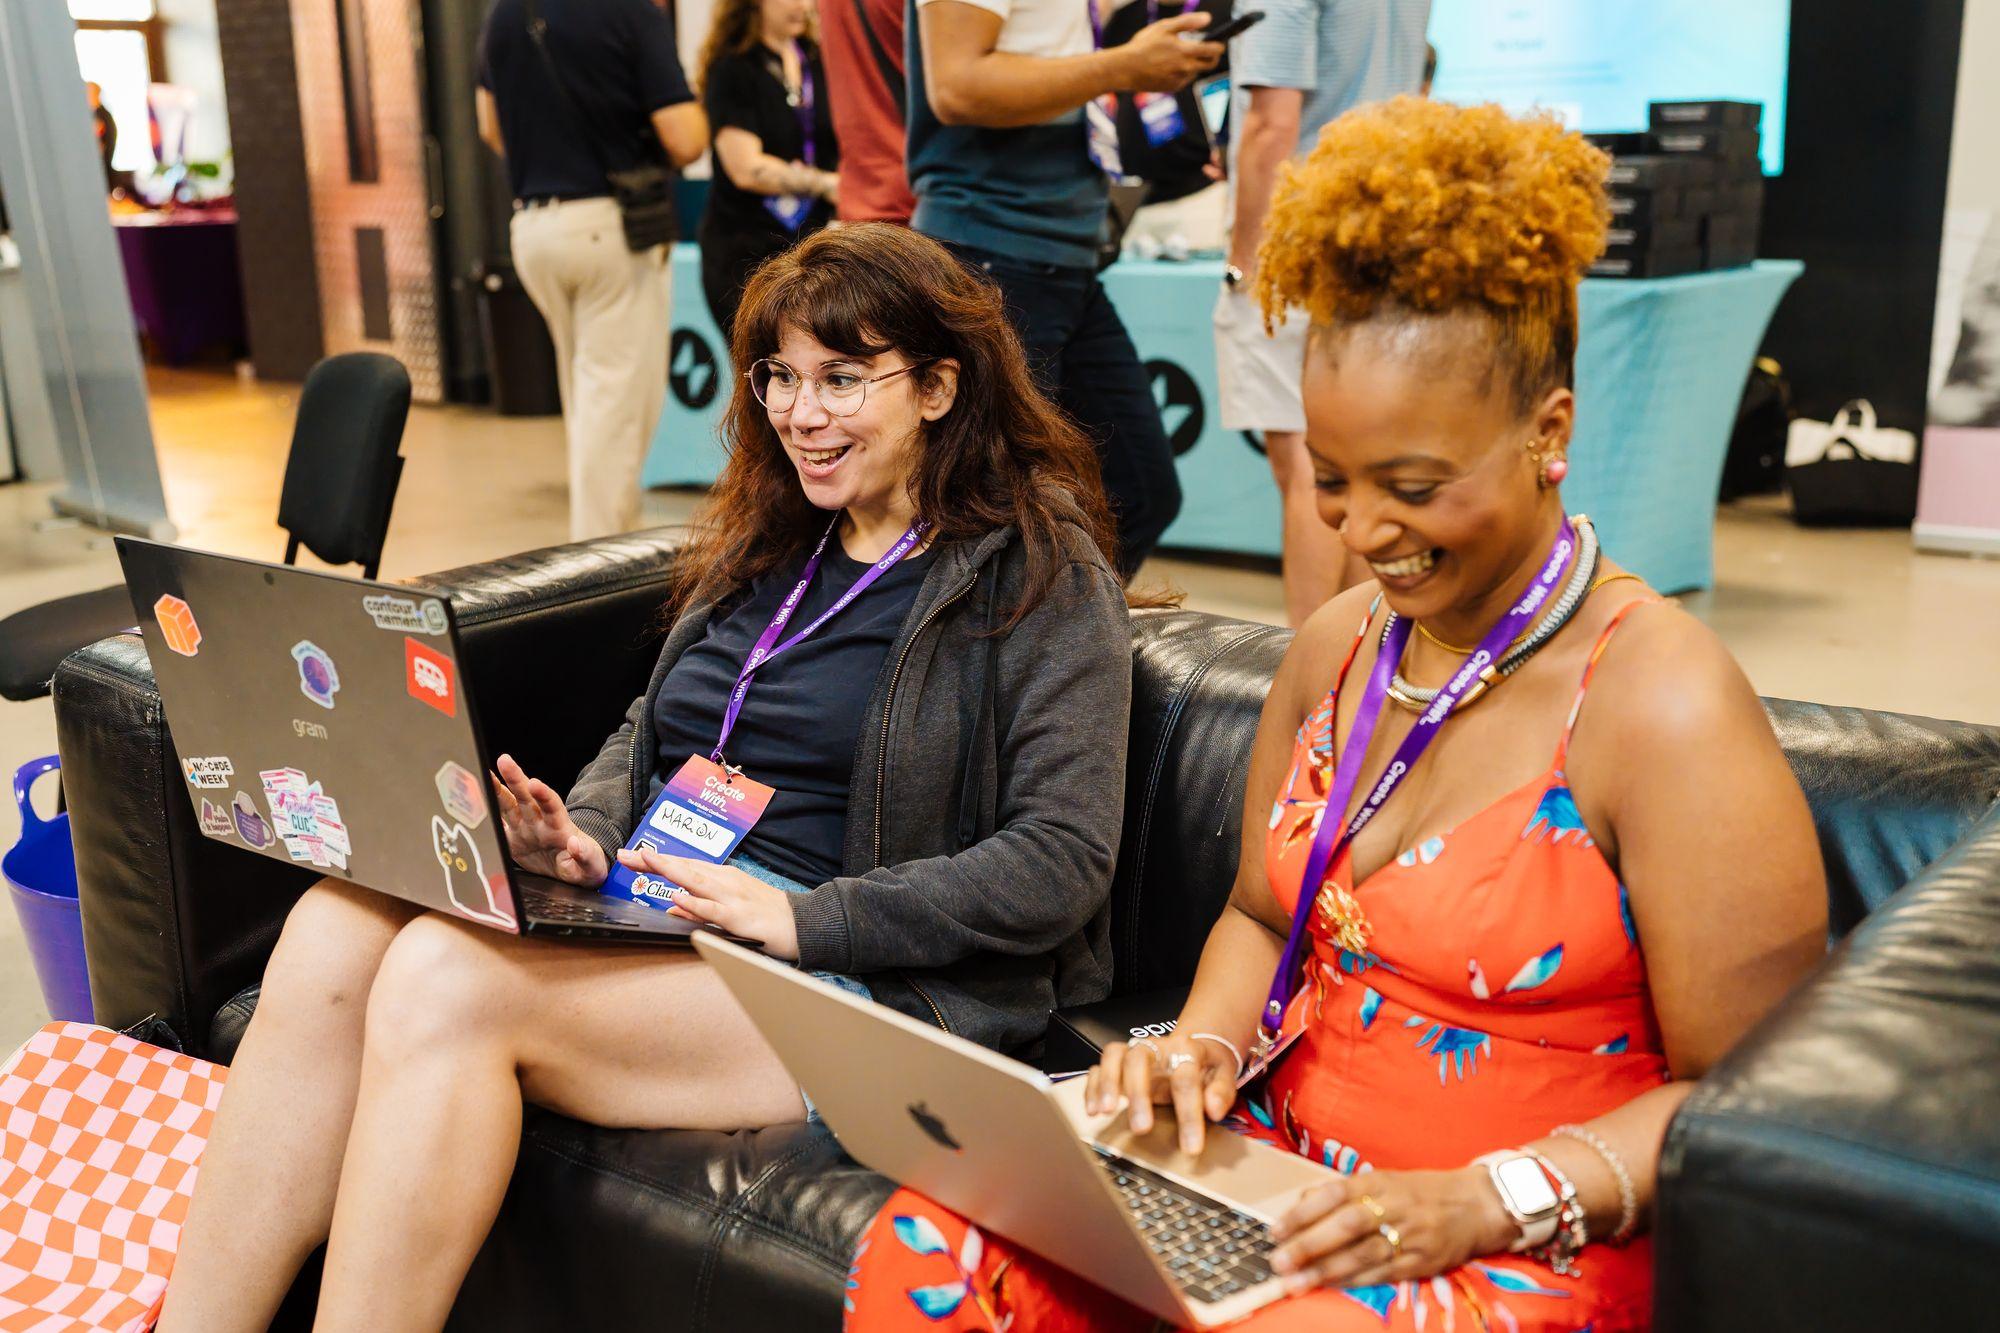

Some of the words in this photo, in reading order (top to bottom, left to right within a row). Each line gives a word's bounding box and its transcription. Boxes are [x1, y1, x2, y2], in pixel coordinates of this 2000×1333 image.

[877, 541, 908, 570] Create
[1542, 539, 1571, 584] Create
[785, 579, 807, 606] Create
[803, 611, 834, 635] Create
[743, 648, 765, 677] Crea
[1449, 650, 1491, 694] Create
[292, 718, 328, 740] gram
[198, 774, 225, 785] WEEK
[704, 775, 746, 802] Create
[1370, 760, 1407, 806] Create
[646, 882, 689, 900] Clau
